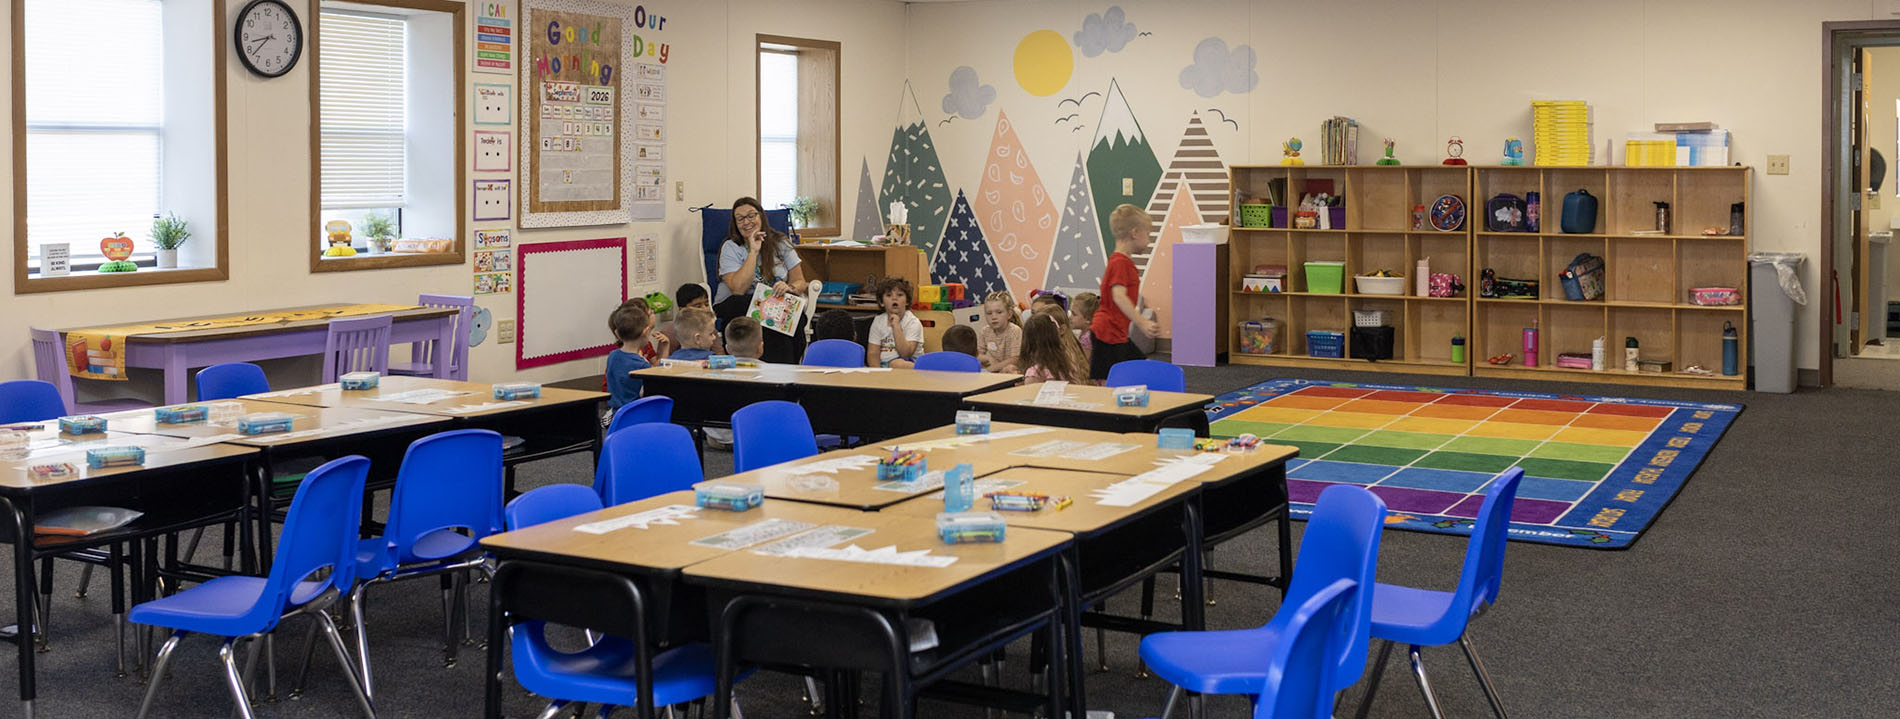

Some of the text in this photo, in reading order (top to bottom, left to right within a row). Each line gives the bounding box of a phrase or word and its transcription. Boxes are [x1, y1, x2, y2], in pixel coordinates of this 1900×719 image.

[264, 8, 272, 17] 12
[488, 3, 506, 17] CAN
[253, 12, 260, 20] 11
[276, 13, 280, 21] 1
[634, 5, 667, 31] Our
[246, 19, 255, 28] 10
[283, 21, 289, 30] 2
[243, 32, 249, 41] 9
[547, 21, 601, 46] Good
[287, 34, 292, 43] 3
[246, 45, 252, 54] 8
[283, 47, 289, 55] 4
[633, 34, 670, 64] Day
[255, 55, 261, 63] 7
[265, 59, 271, 67] 6
[276, 56, 281, 64] 5
[536, 49, 613, 86] Morning
[591, 91, 610, 102] 2026
